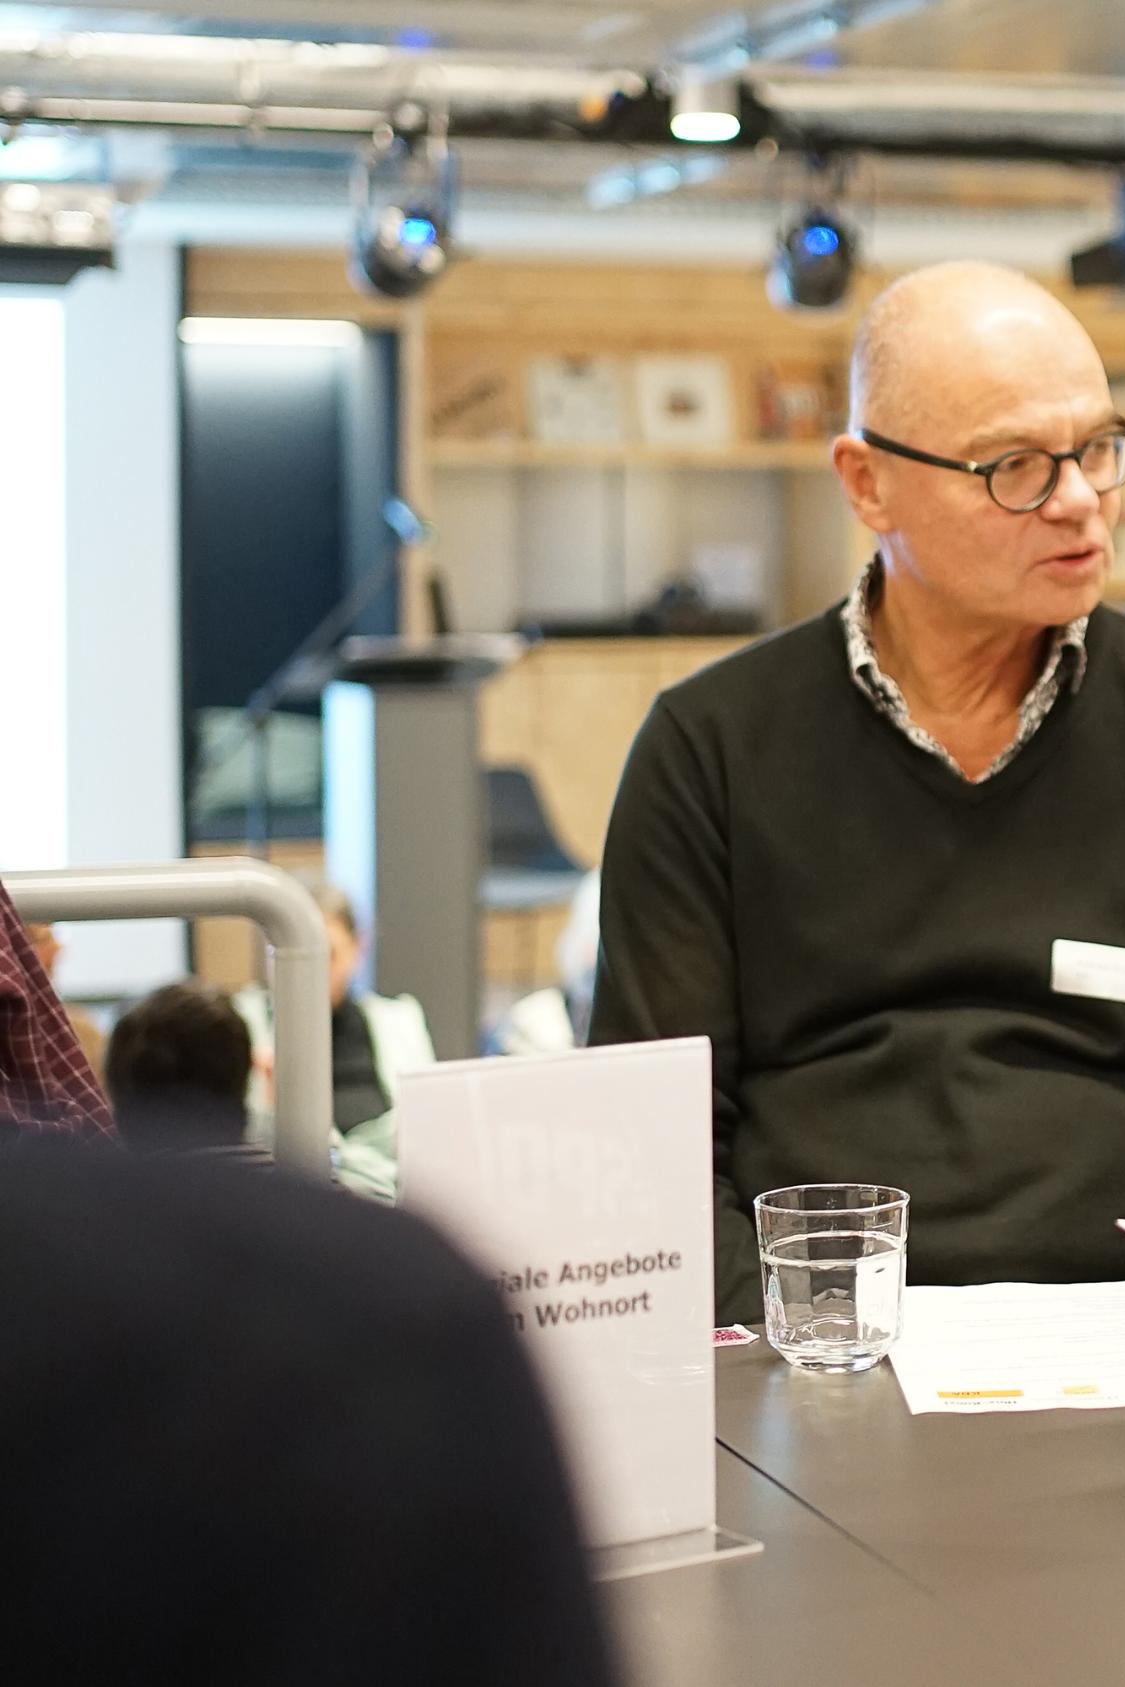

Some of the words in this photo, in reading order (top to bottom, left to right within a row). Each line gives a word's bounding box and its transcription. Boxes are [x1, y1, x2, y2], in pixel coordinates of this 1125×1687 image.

[498, 1266, 549, 1293] iale
[558, 1250, 682, 1287] Angebote
[534, 1291, 652, 1328] Wohnort
